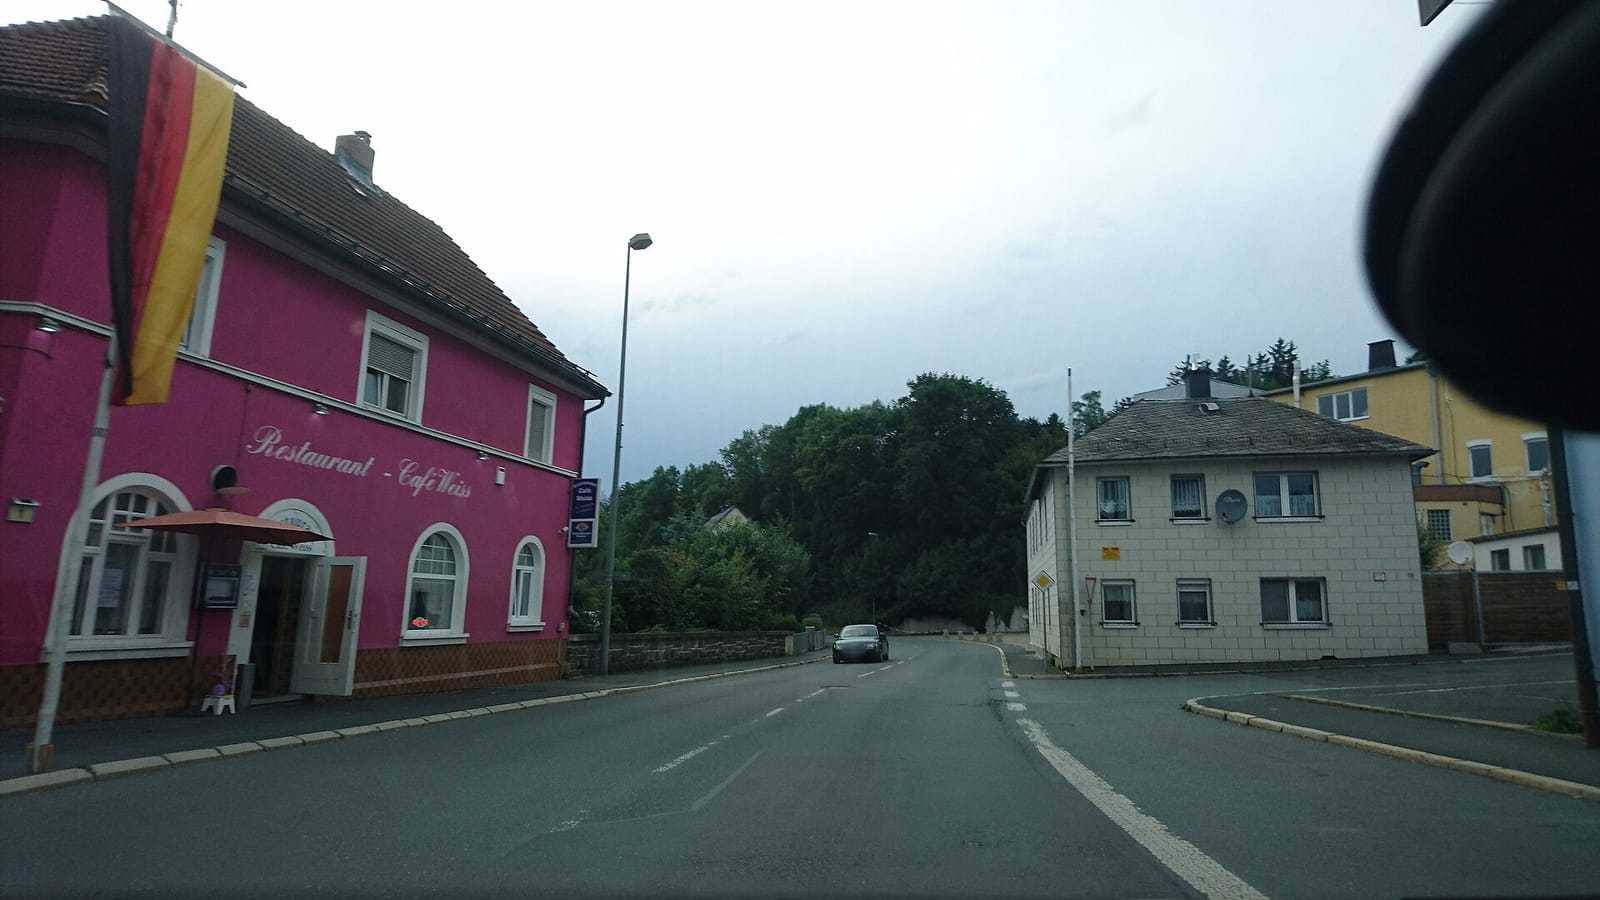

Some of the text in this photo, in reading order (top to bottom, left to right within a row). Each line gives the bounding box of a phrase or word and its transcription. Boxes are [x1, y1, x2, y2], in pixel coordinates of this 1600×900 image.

[245, 425, 376, 477] Restaurant
[398, 458, 437, 497] Café
[436, 468, 472, 498] Weiss
